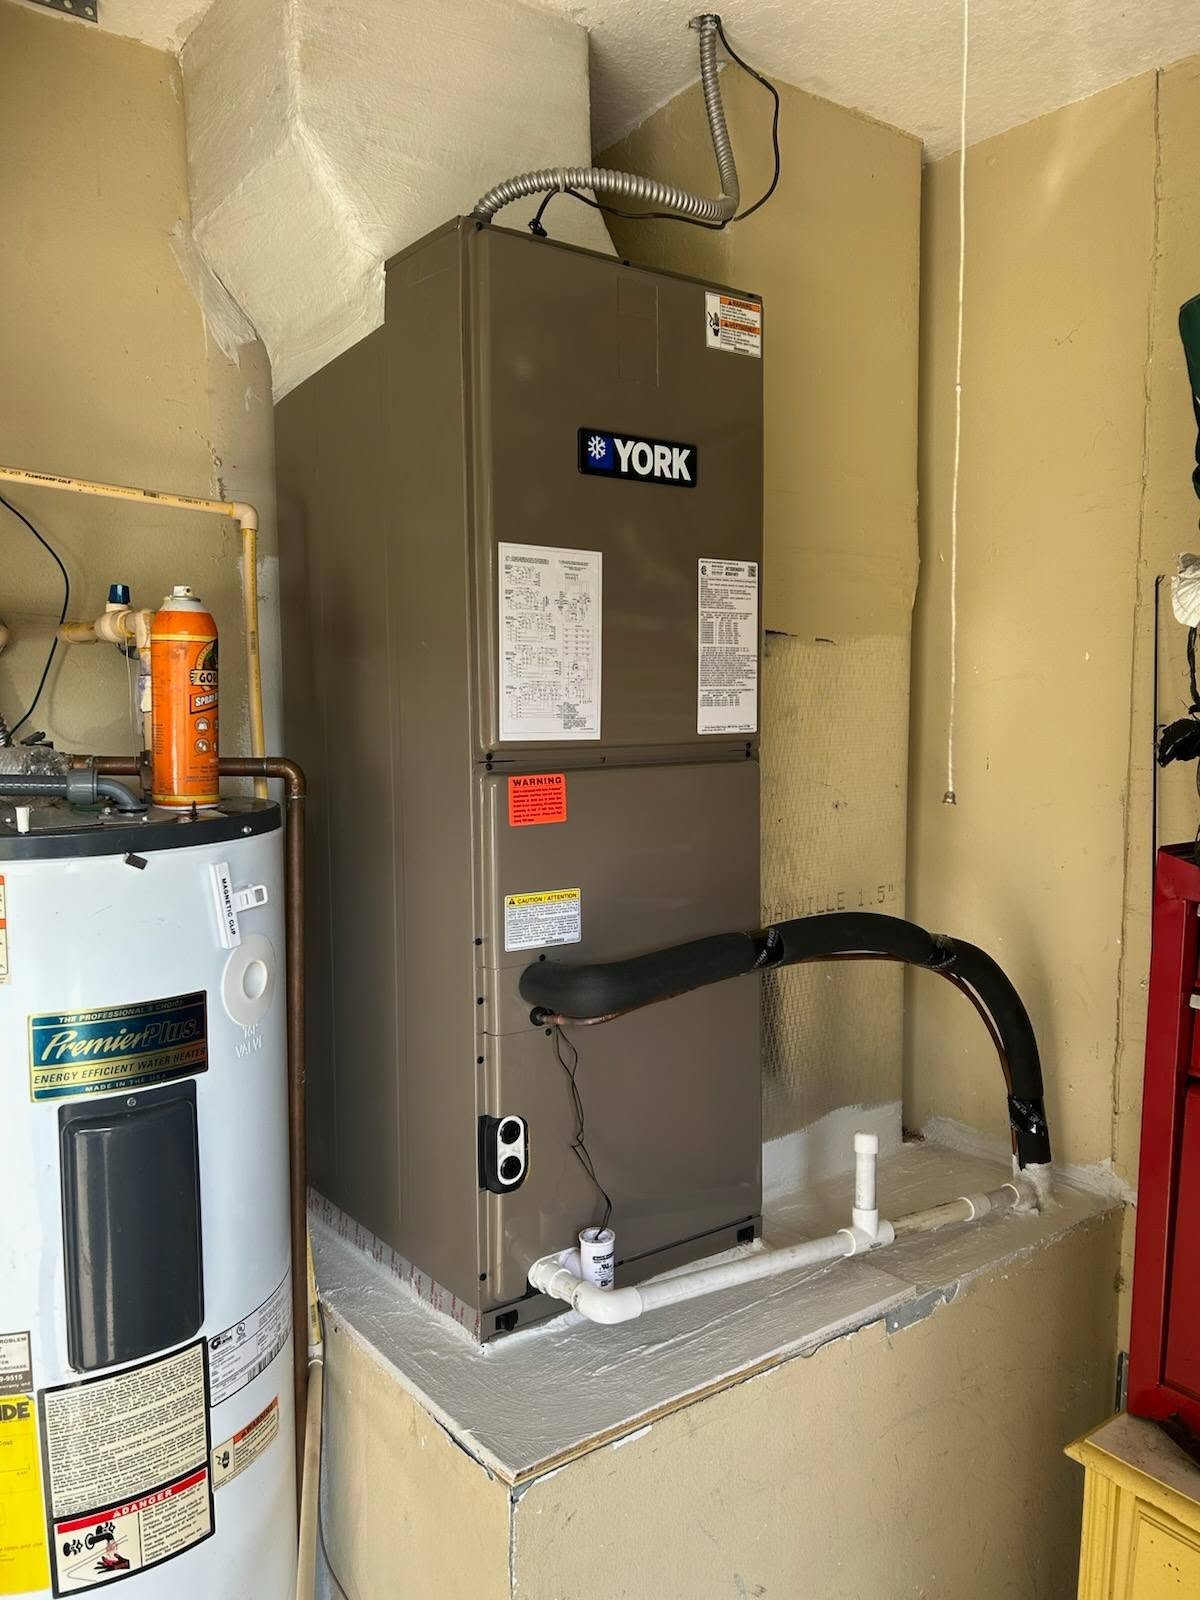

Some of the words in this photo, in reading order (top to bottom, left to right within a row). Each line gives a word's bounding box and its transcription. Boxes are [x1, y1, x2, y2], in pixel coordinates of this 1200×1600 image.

[613, 438, 692, 481] YORK
[512, 776, 562, 787] WARNING
[221, 878, 233, 918] MAGNETIC
[229, 919, 237, 936] CLIP
[517, 896, 543, 905] CAUTION
[547, 892, 577, 901] ATTENTION
[58, 1016, 76, 1024] THE
[34, 1072, 79, 1085] ENERGY
[81, 1063, 135, 1079] EFFICIENT
[137, 1056, 171, 1071] WATER
[173, 1049, 206, 1064] HEATER
[85, 1083, 112, 1093] MADE
[121, 1489, 173, 1515] DANGER
